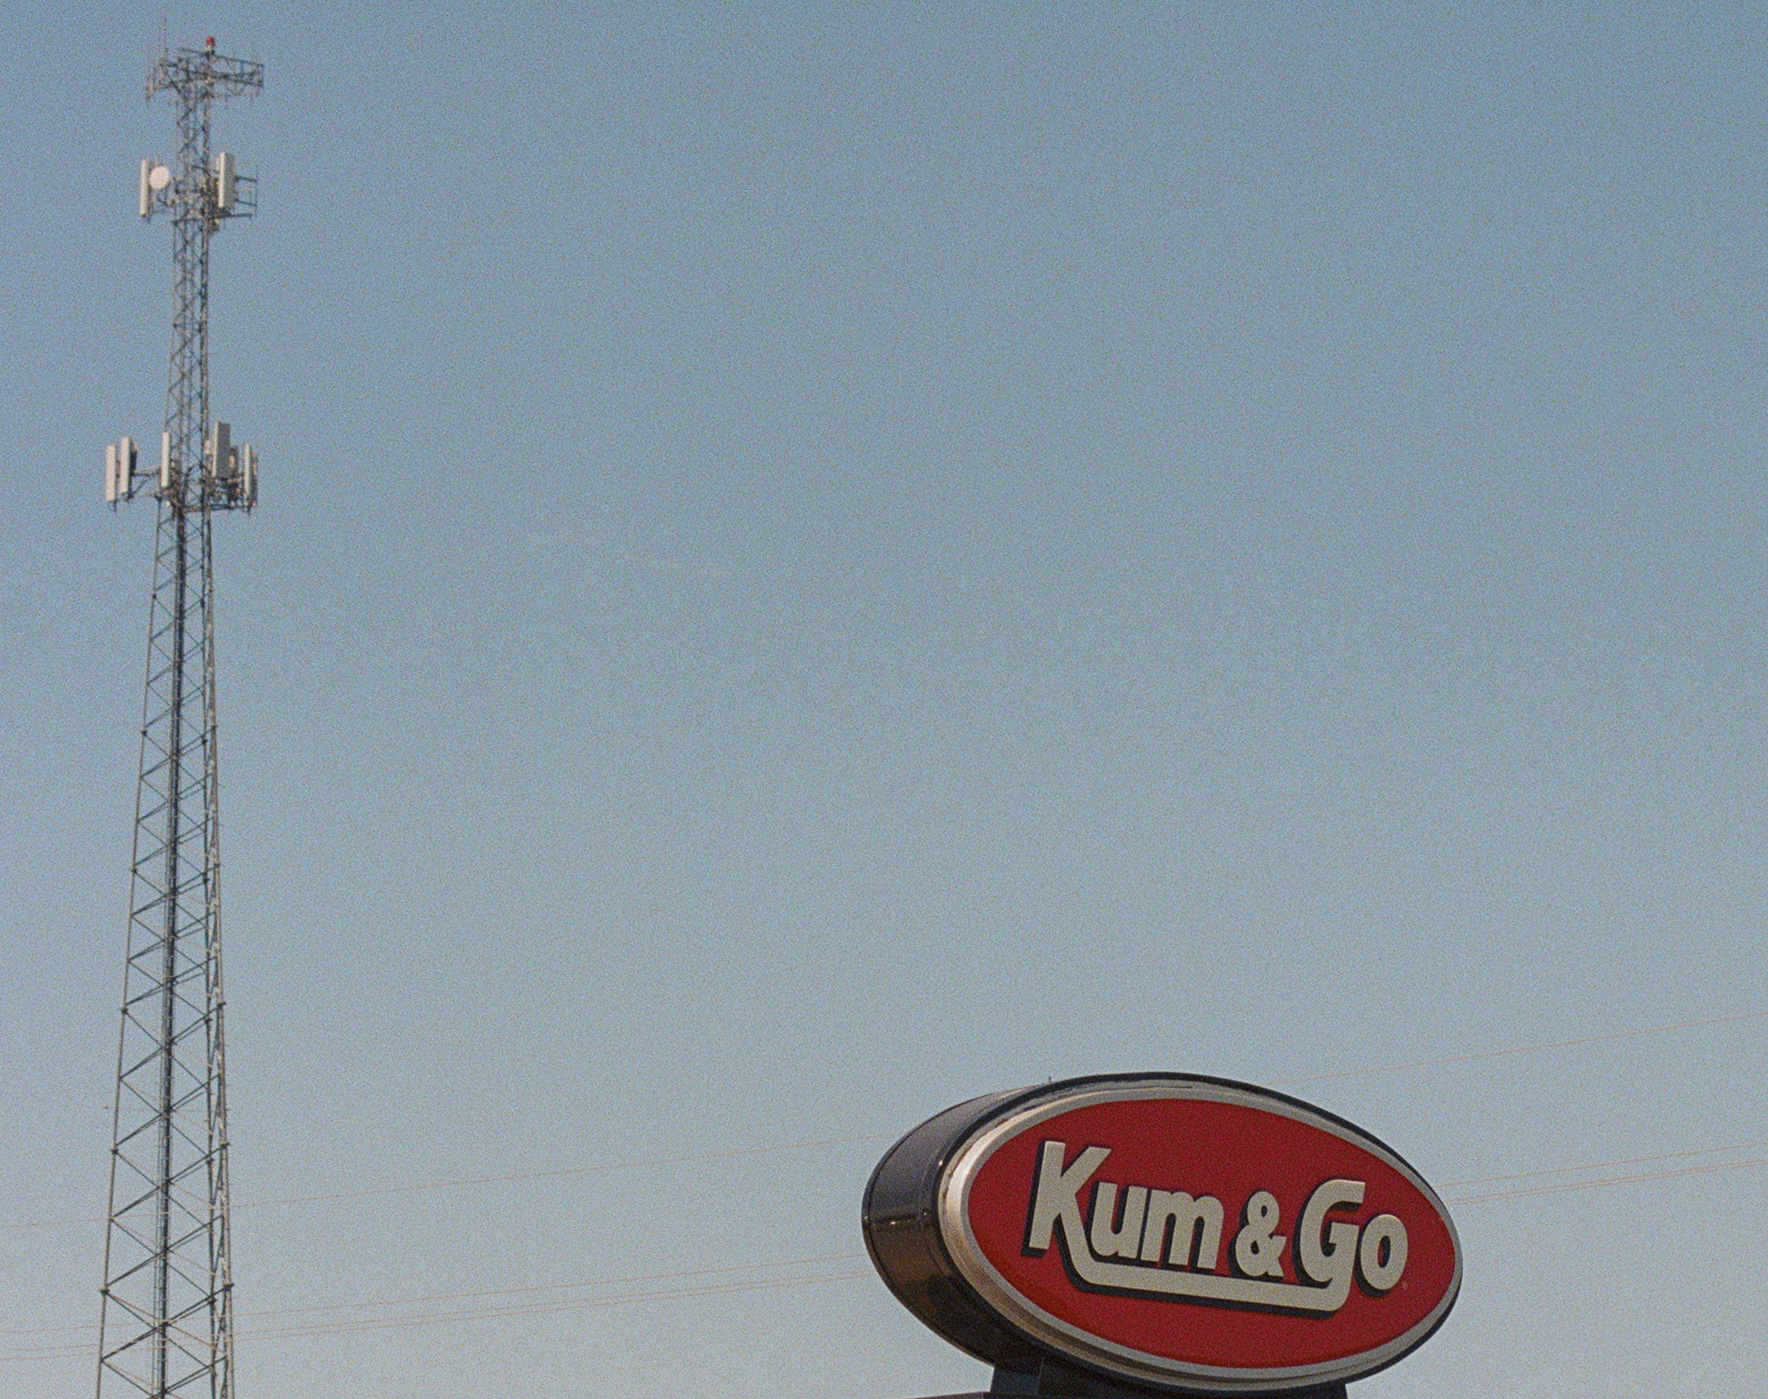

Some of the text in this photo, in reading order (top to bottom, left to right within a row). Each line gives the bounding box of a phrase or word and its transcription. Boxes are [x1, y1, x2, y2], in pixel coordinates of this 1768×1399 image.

[1026, 1140, 1409, 1308] Kum & Go
